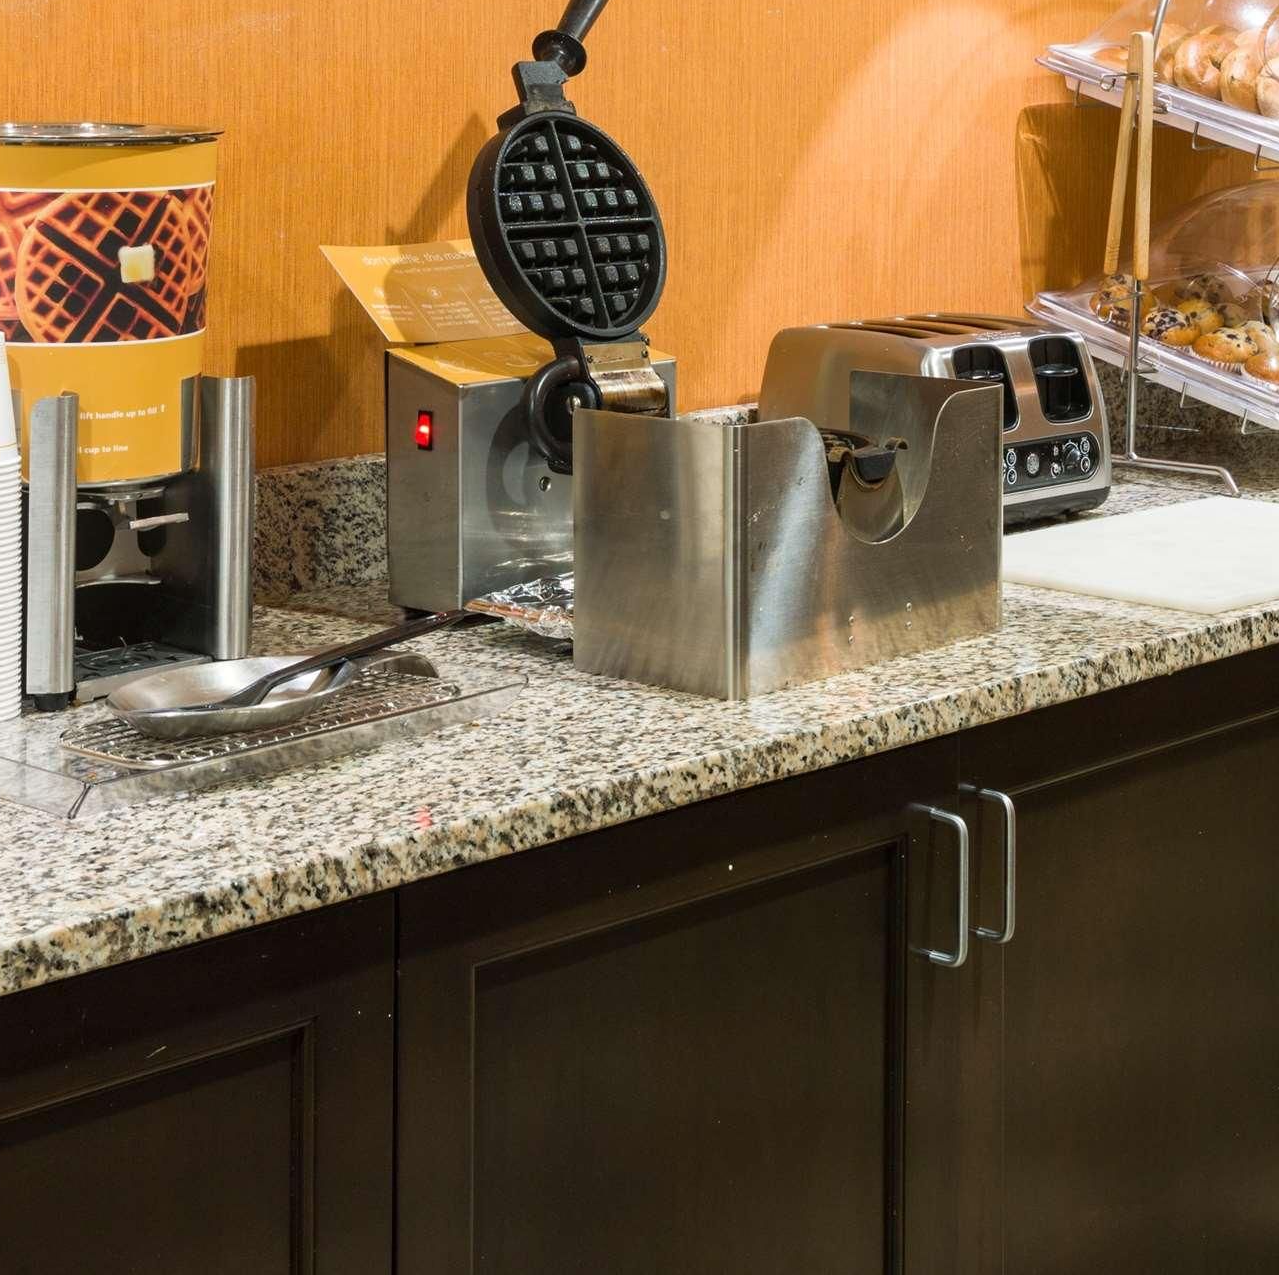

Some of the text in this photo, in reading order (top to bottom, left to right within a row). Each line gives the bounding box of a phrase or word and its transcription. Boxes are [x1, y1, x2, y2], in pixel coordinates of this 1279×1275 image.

[95, 410, 124, 420] handle
[126, 411, 136, 419] up
[137, 409, 146, 417] to
[84, 446, 100, 456] cup
[102, 444, 111, 453] to
